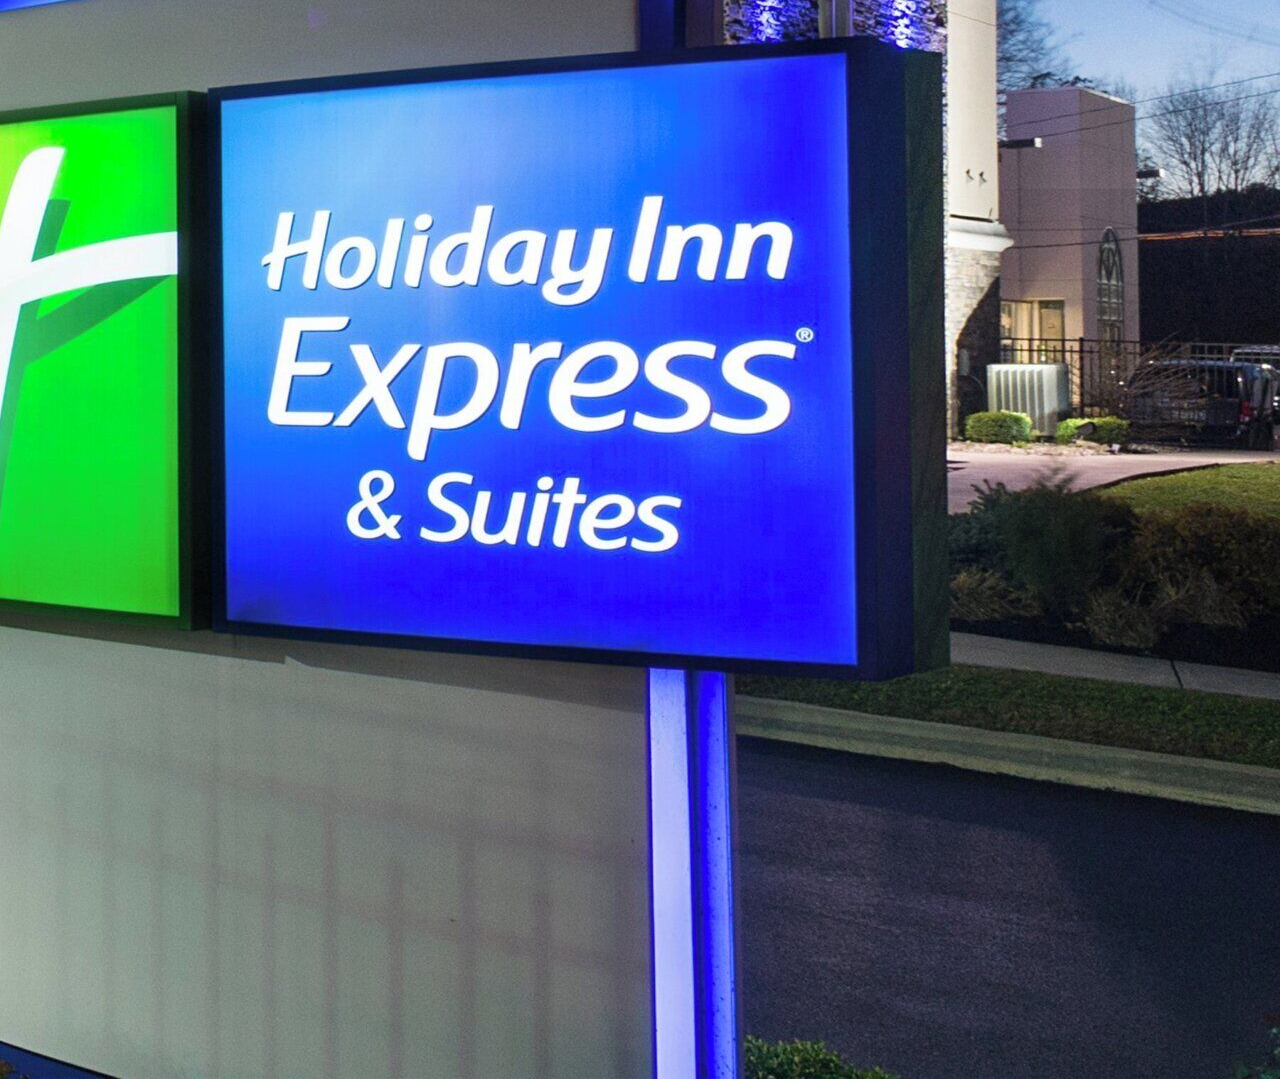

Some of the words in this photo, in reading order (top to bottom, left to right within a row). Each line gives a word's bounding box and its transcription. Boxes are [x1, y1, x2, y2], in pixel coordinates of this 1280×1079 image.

[260, 204, 614, 306] Holiday
[627, 195, 794, 283] Inn
[346, 469, 402, 540] &
[419, 471, 682, 552] Suites
